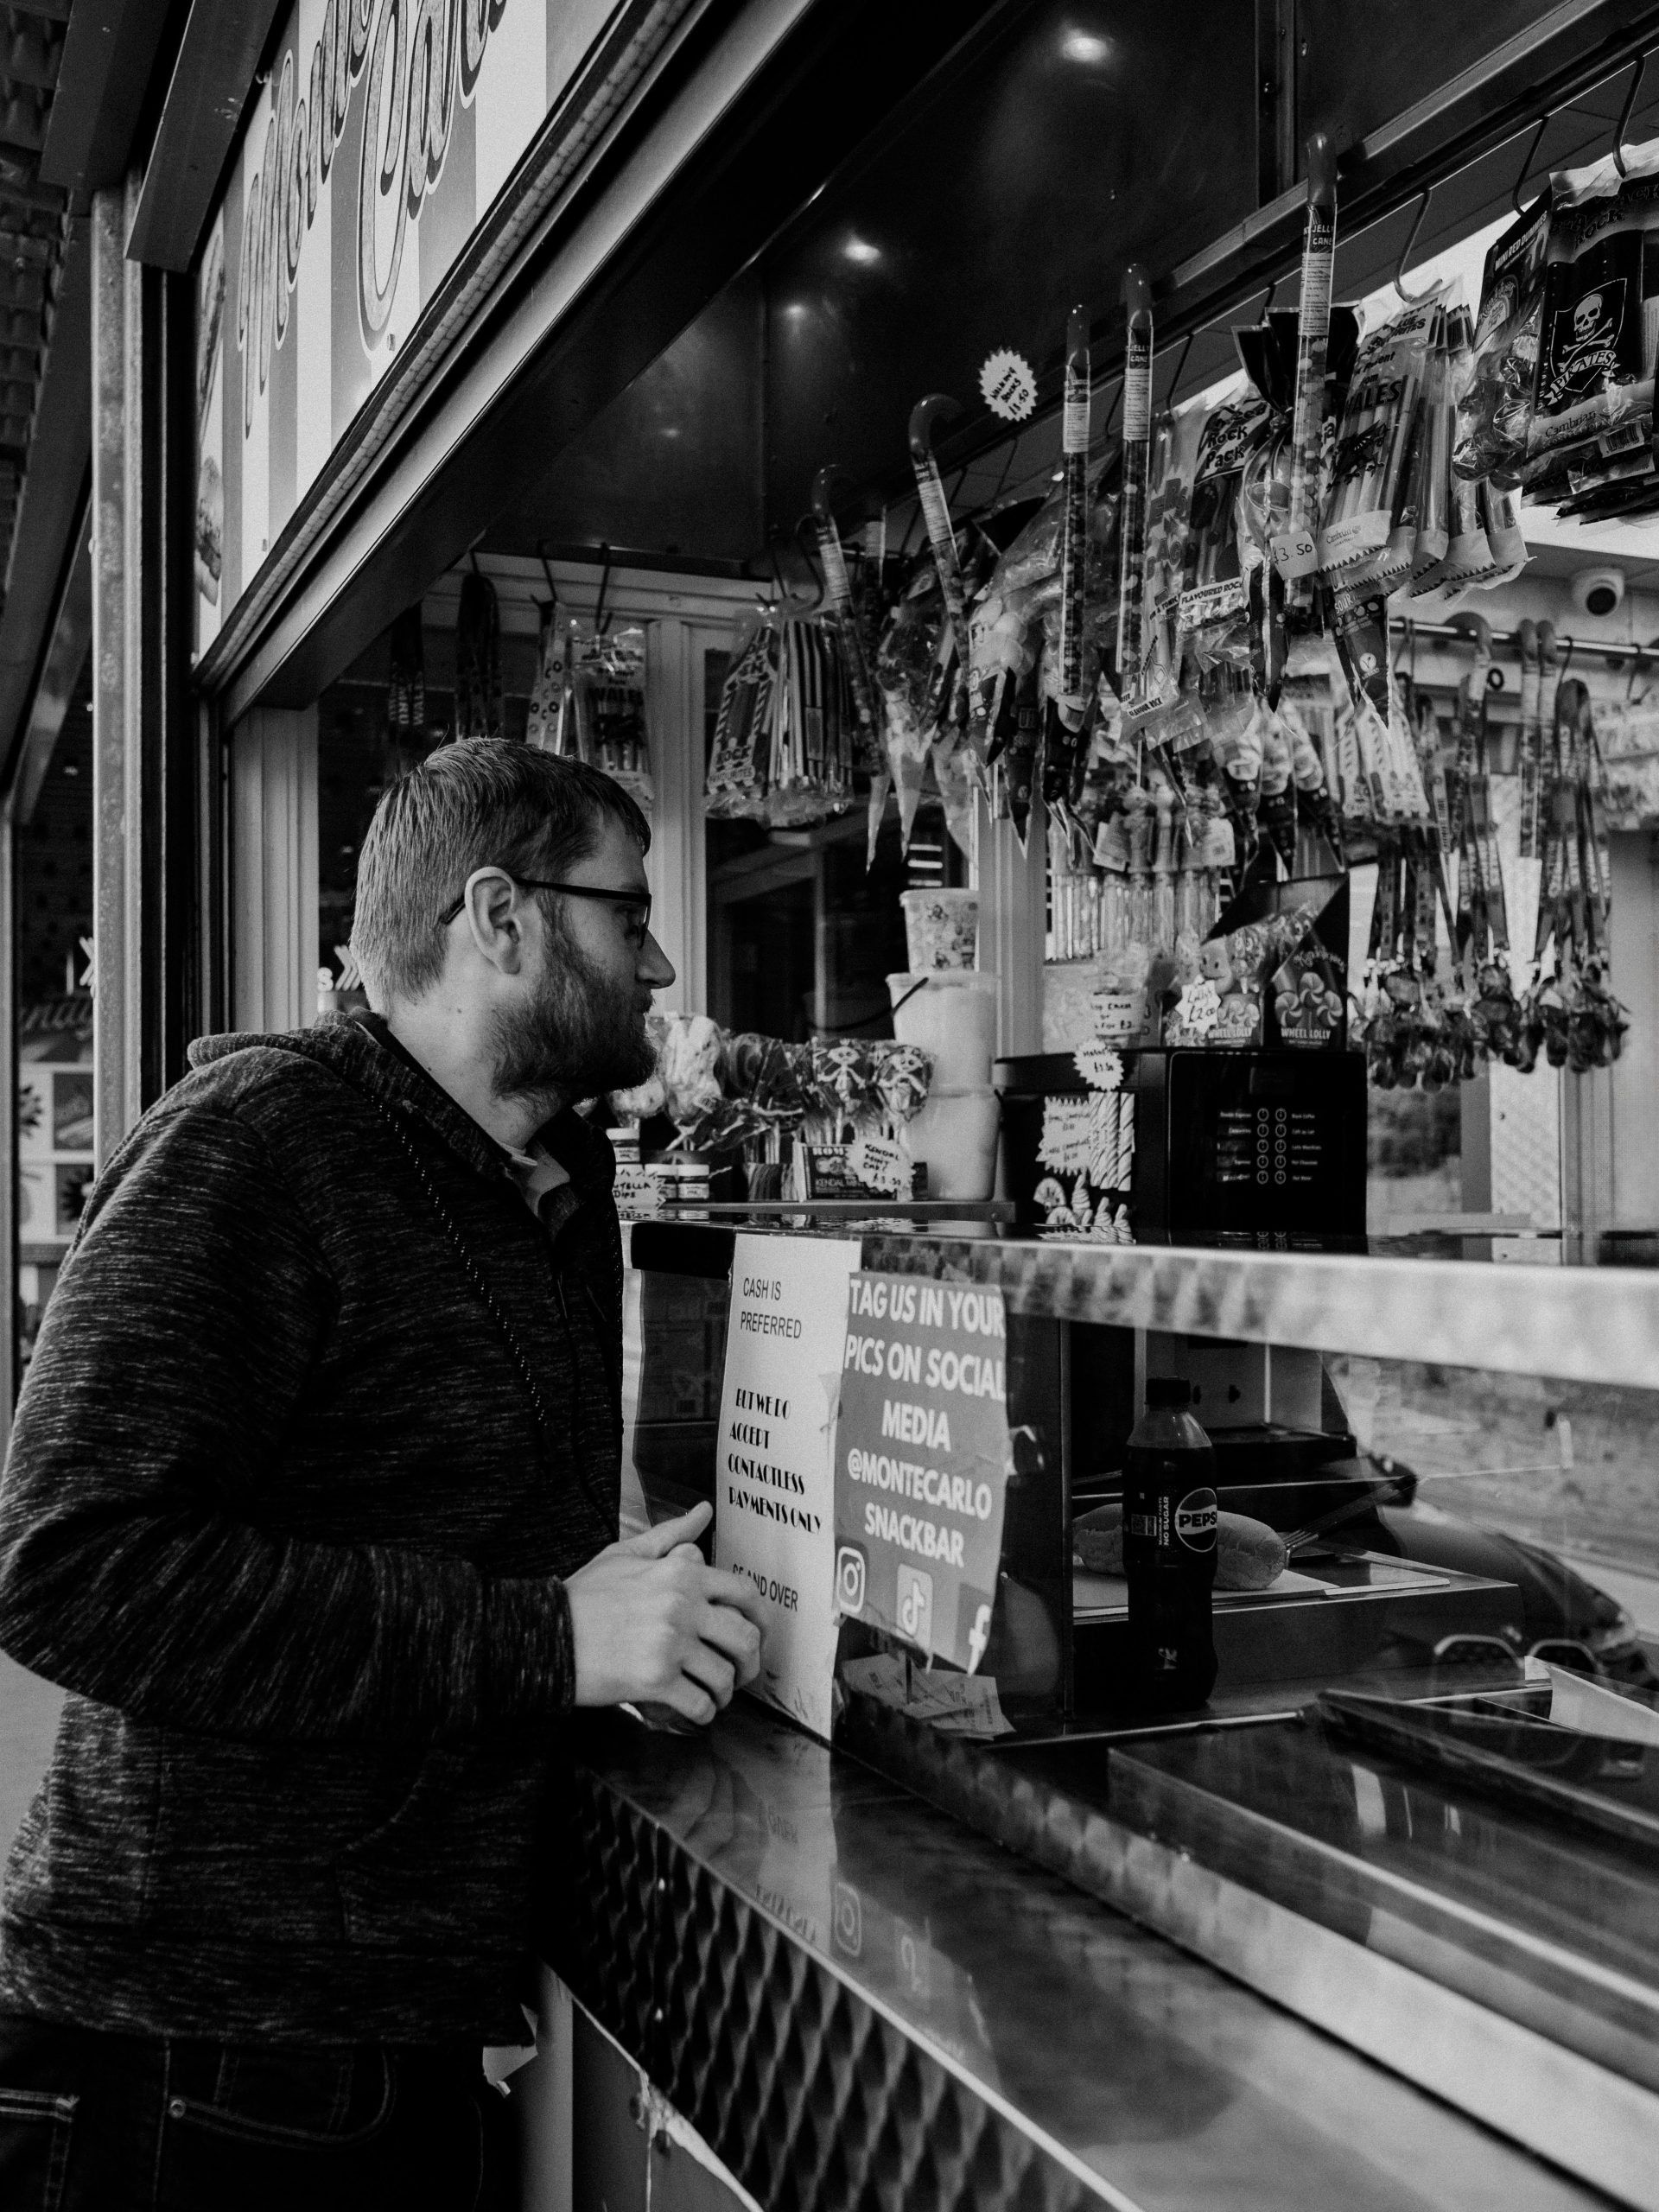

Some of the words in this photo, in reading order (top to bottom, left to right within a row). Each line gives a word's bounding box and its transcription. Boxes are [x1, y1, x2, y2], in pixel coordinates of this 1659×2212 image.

[1553, 351, 1614, 391] PIRATES
[1545, 410, 1597, 437] Cambrian
[1271, 543, 1313, 565] £3.50
[1180, 585, 1222, 605] FLAVOURED
[1334, 593, 1354, 614] SOUR
[1281, 1027, 1308, 1039] WHEEL
[1309, 1028, 1332, 1039] LOLLY
[864, 1143, 899, 1161] KENDAL
[743, 1277, 768, 1300] CASH
[771, 1280, 782, 1300] IS
[849, 1278, 888, 1319] TAG
[889, 1284, 918, 1324] US
[918, 1287, 944, 1328] IN
[946, 1290, 1007, 1338] YOUR
[741, 1311, 802, 1338] PREFERRED
[843, 1333, 886, 1376] PICS
[887, 1342, 922, 1384] ON
[925, 1348, 1007, 1402] SOCIAL
[735, 1388, 754, 1410] BUT
[755, 1393, 773, 1416] WE
[774, 1398, 791, 1420] DO
[729, 1421, 771, 1449] ACCEPT
[881, 1399, 952, 1452] MEDIA
[728, 1453, 805, 1495] CONTACTLESS
[847, 1447, 993, 1521] @MONTECARLO
[728, 1486, 788, 1524] PAYMENTS
[790, 1513, 822, 1535] ONLY
[1162, 1496, 1171, 1530] SUGAR
[1179, 1512, 1217, 1528] PEPS
[864, 1502, 964, 1568] SNACKBAR
[1162, 1531, 1171, 1546] NO
[769, 1580, 798, 1612] OVER
